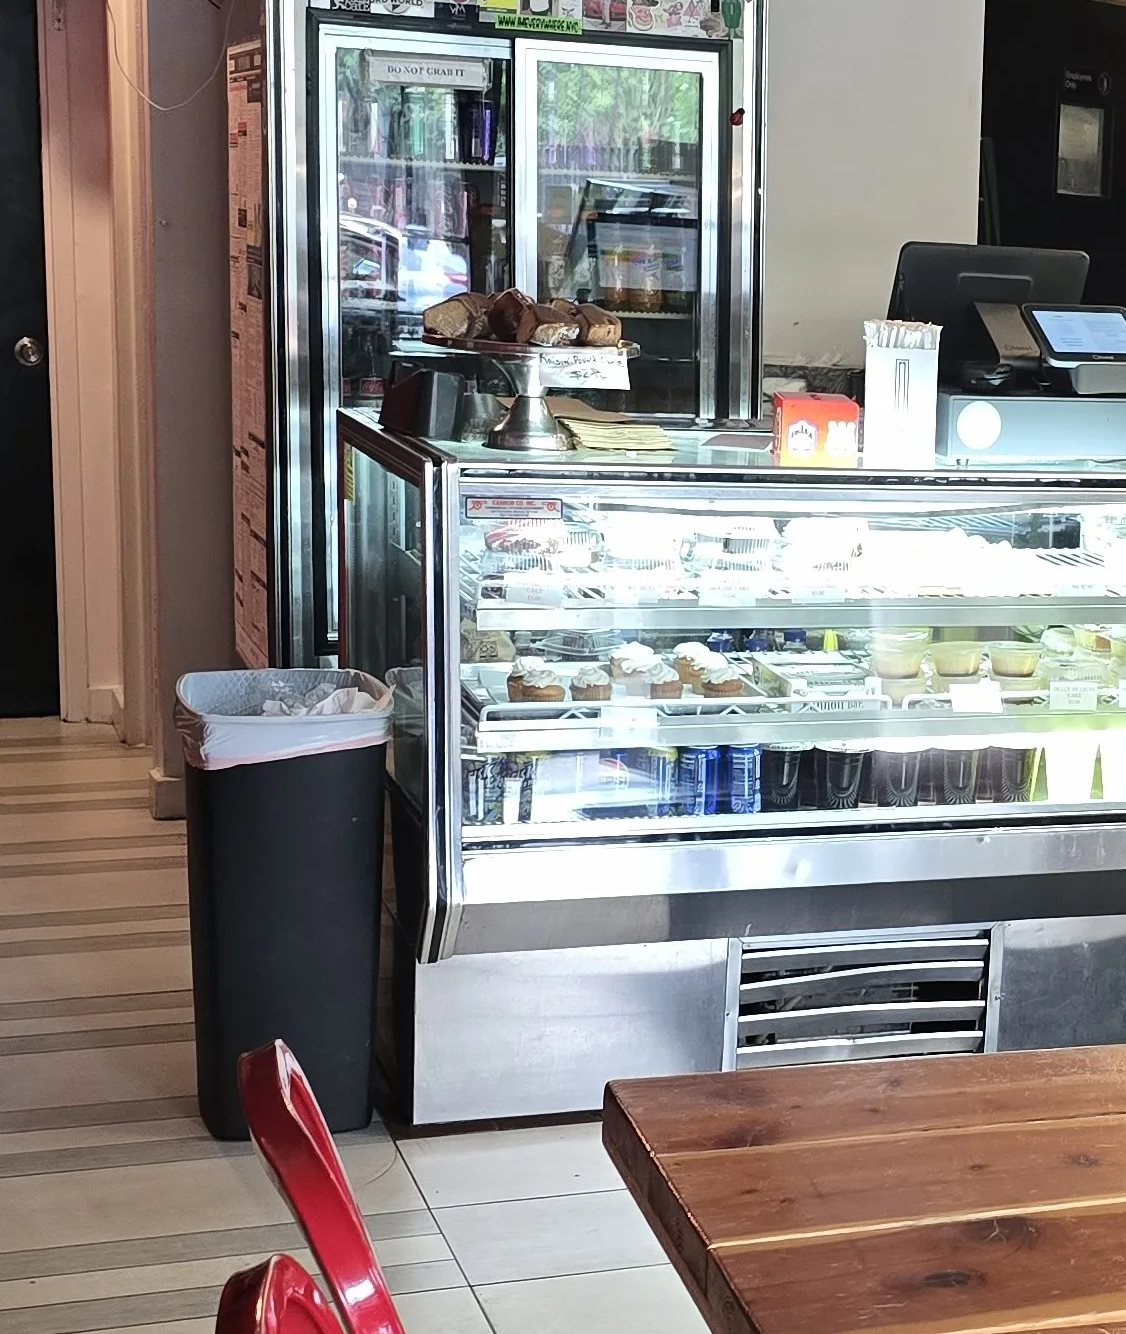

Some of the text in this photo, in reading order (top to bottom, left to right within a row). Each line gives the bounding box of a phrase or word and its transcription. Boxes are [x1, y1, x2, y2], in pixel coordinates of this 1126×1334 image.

[387, 65, 401, 74] DO
[403, 66, 424, 76] NOT
[455, 68, 466, 78] IT
